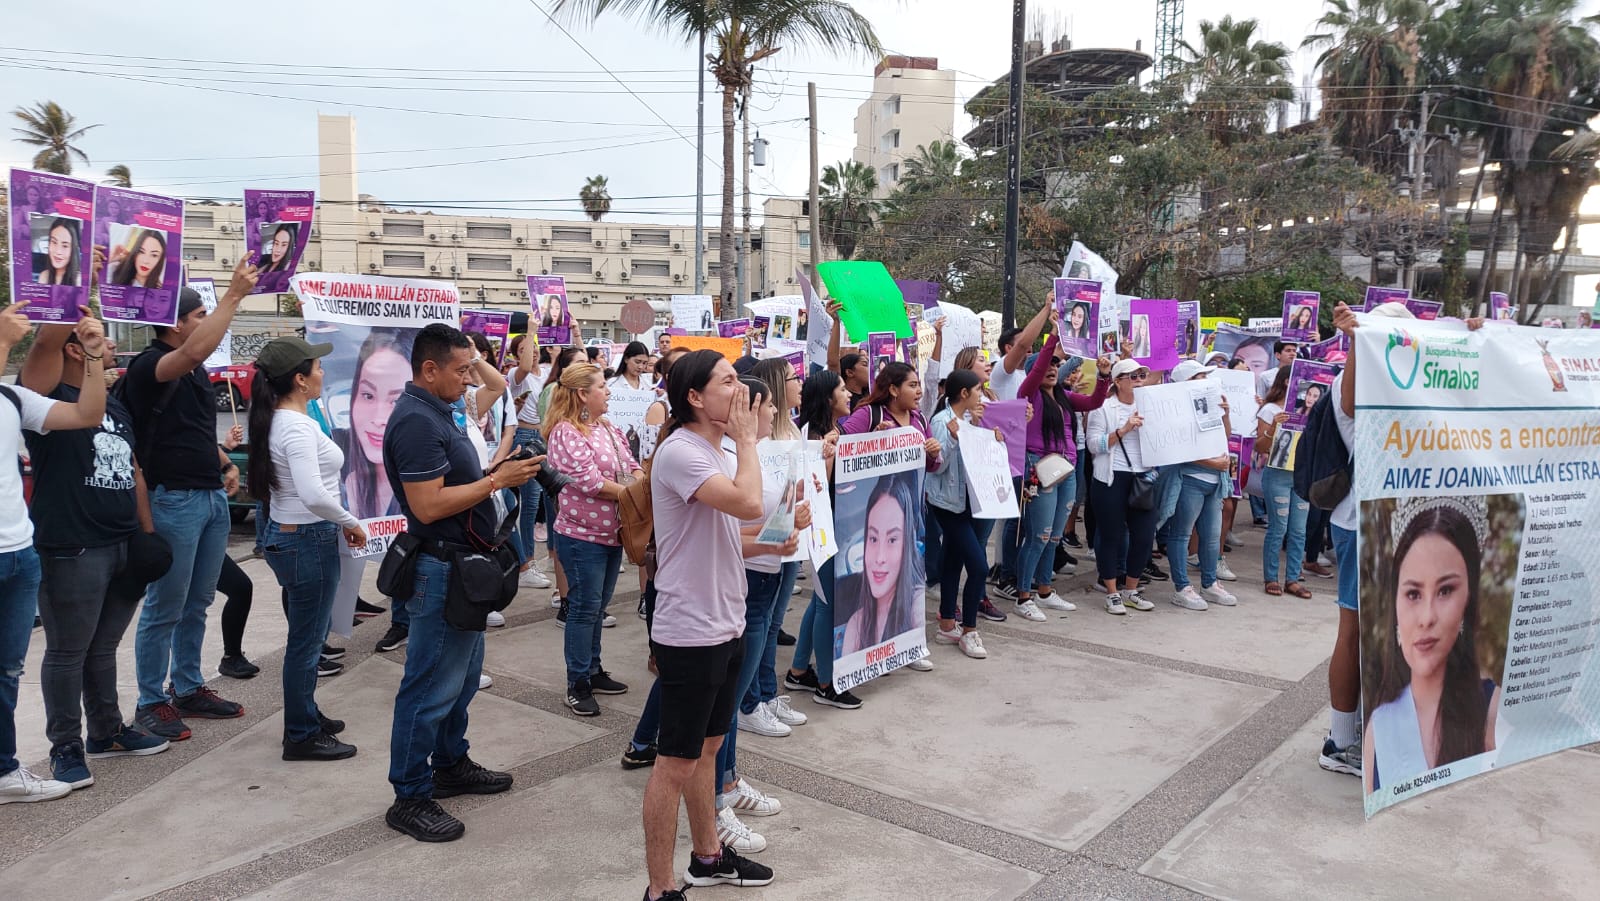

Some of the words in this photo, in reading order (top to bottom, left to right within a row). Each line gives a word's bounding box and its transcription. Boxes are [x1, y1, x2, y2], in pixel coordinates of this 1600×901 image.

[299, 281, 326, 295] AIME
[329, 282, 371, 298] JOANNA
[376, 284, 414, 302] MILLÁN
[416, 288, 458, 304] ESTRADA
[313, 297, 325, 312] TE
[325, 299, 381, 316] QUEREMOS
[383, 303, 410, 318] SANA
[414, 305, 421, 319] Y
[423, 305, 453, 320] SALVA
[1423, 361, 1479, 390] Sinaloa
[838, 442, 854, 457] AIME
[855, 439, 879, 455] JOANNA
[879, 433, 899, 451] MILLÁN
[899, 432, 923, 447] ESTRADA
[1383, 420, 1492, 459] Ayúdanos
[1500, 428, 1512, 449] a
[1519, 422, 1600, 448] encontra
[843, 459, 851, 473] TE
[851, 453, 883, 472] QUEREMOS
[884, 451, 899, 466] SANA
[900, 451, 904, 463] Y
[904, 447, 921, 462] SALVA
[1383, 467, 1433, 490] AIME
[1435, 466, 1504, 488] JOANNA
[1503, 458, 1554, 485] MILLÁN
[1558, 460, 1600, 482] ESTRA
[1529, 495, 1543, 503] Fecha
[1544, 494, 1550, 502] de
[1551, 491, 1586, 502] Desaparición:
[1539, 508, 1550, 517] Abril
[1554, 506, 1567, 515] 2023
[368, 519, 408, 537] INFORME
[1530, 522, 1556, 531] Municipio
[1566, 520, 1582, 528] hecho:
[384, 535, 391, 550] Y
[1525, 550, 1540, 558] Sexo:
[1541, 548, 1558, 558] Mujer
[1523, 563, 1539, 572] Edad:
[1539, 562, 1547, 571] 23
[1547, 561, 1560, 570] años
[1521, 577, 1545, 586] Estatura:
[1546, 574, 1558, 583] 1.65
[1520, 591, 1531, 600] Tez:
[1532, 589, 1550, 598] Blanca
[1517, 601, 1551, 613] Complexión:
[1552, 600, 1572, 609] Delgada
[1515, 618, 1530, 626] Cara:
[1531, 616, 1553, 624] Ovalada
[1513, 631, 1529, 641] Ojos:
[1529, 628, 1555, 637] Medianos
[866, 641, 896, 665] INFORMES
[1512, 645, 1529, 653] Nariz:
[1529, 642, 1553, 651] Mediana
[879, 661, 885, 673] Y
[1511, 657, 1533, 667] Cabello:
[1533, 655, 1548, 664] Largo
[1508, 672, 1529, 681] Frente:
[1529, 667, 1551, 676] Mediana
[1506, 686, 1522, 694] Boca:
[1504, 698, 1520, 707] Cejas:
[1521, 693, 1544, 703] Pobladas
[1393, 783, 1413, 795] Cedula:
